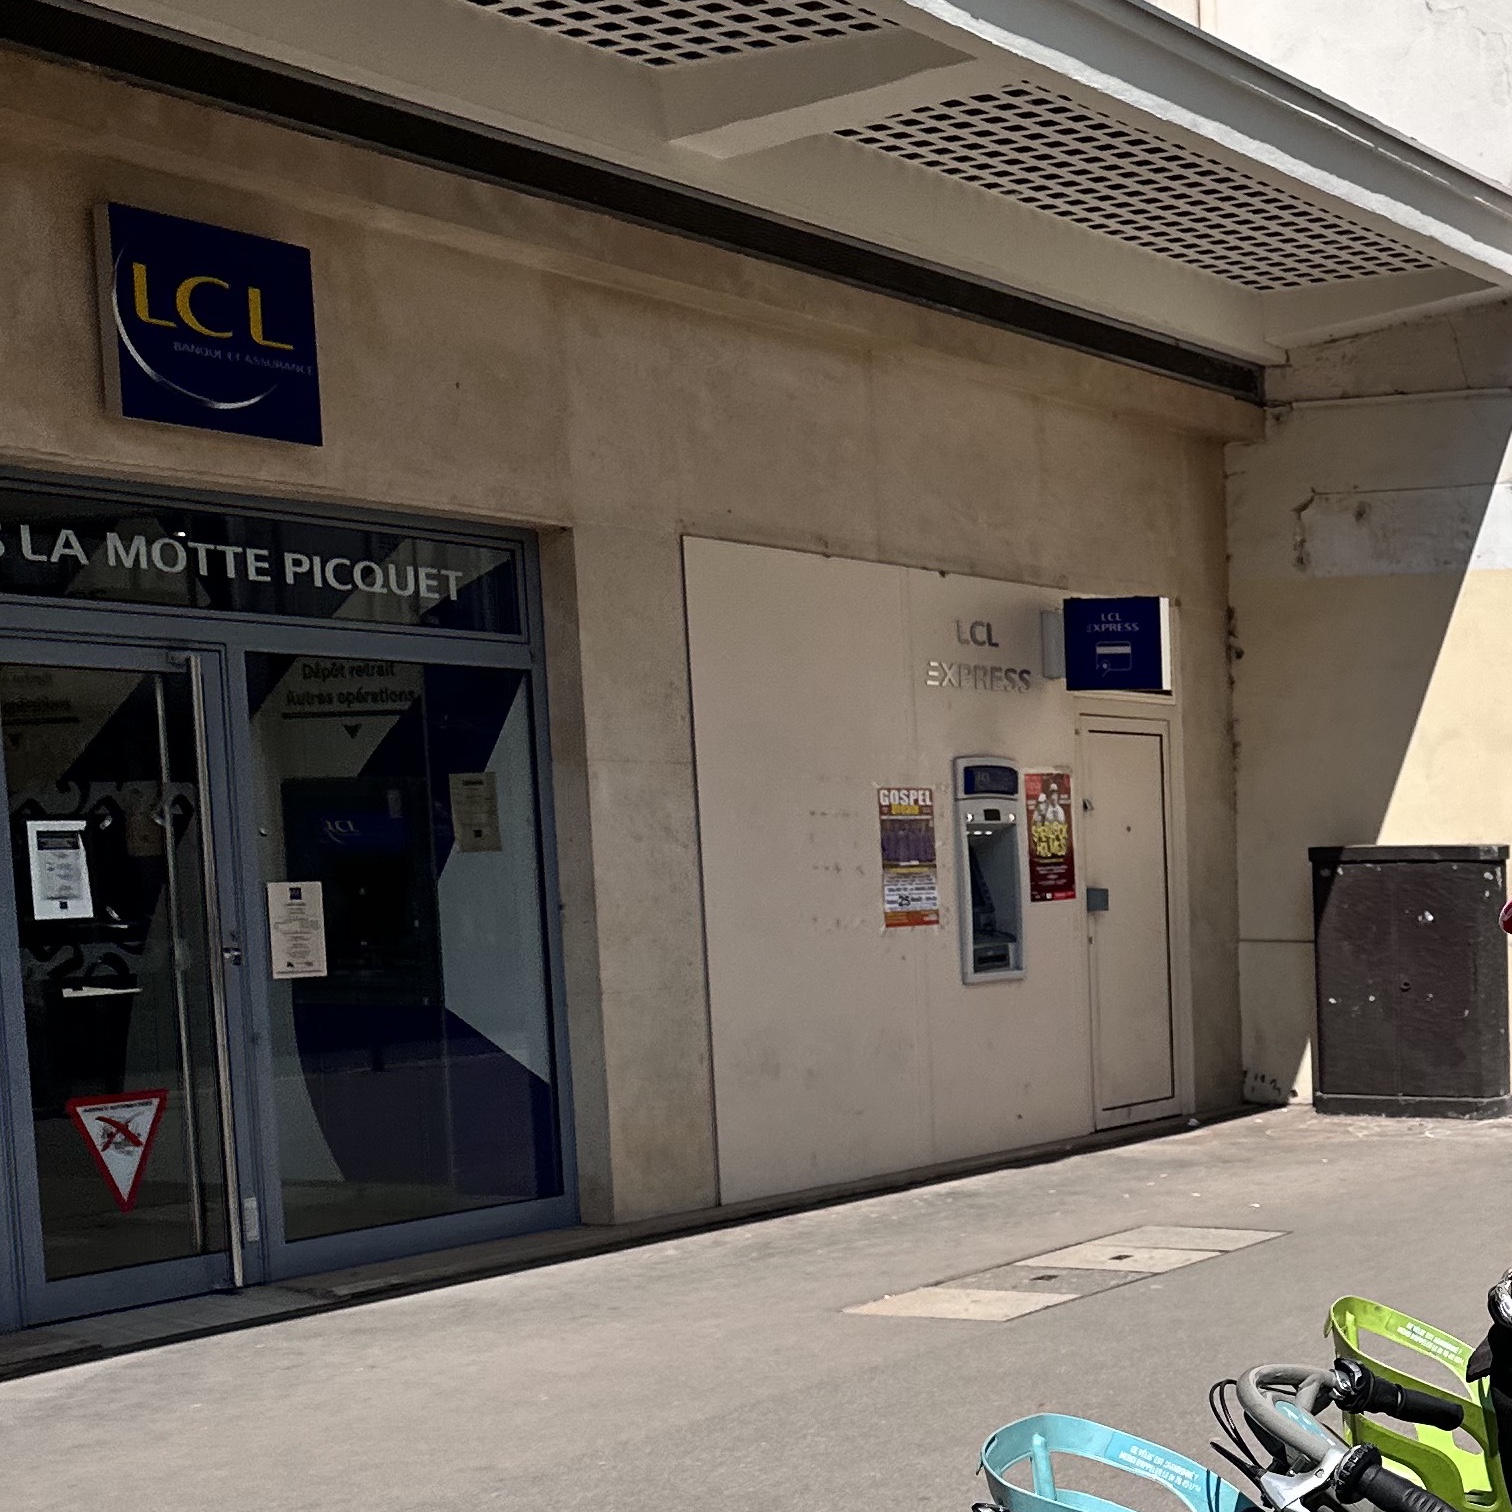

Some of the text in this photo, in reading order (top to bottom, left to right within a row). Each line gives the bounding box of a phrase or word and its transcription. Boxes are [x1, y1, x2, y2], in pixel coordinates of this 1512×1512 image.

[132, 261, 294, 350] LCL
[19, 524, 89, 565] LA
[106, 531, 271, 582] MOTTE
[283, 551, 464, 600] PICQUET
[1086, 622, 1140, 633] EXPRESS
[1100, 612, 1122, 622] LCL
[954, 619, 1000, 648] LCL
[925, 661, 1031, 694] EXPRESS
[286, 686, 416, 708] Autres opérations
[879, 789, 932, 806] GOSPEL
